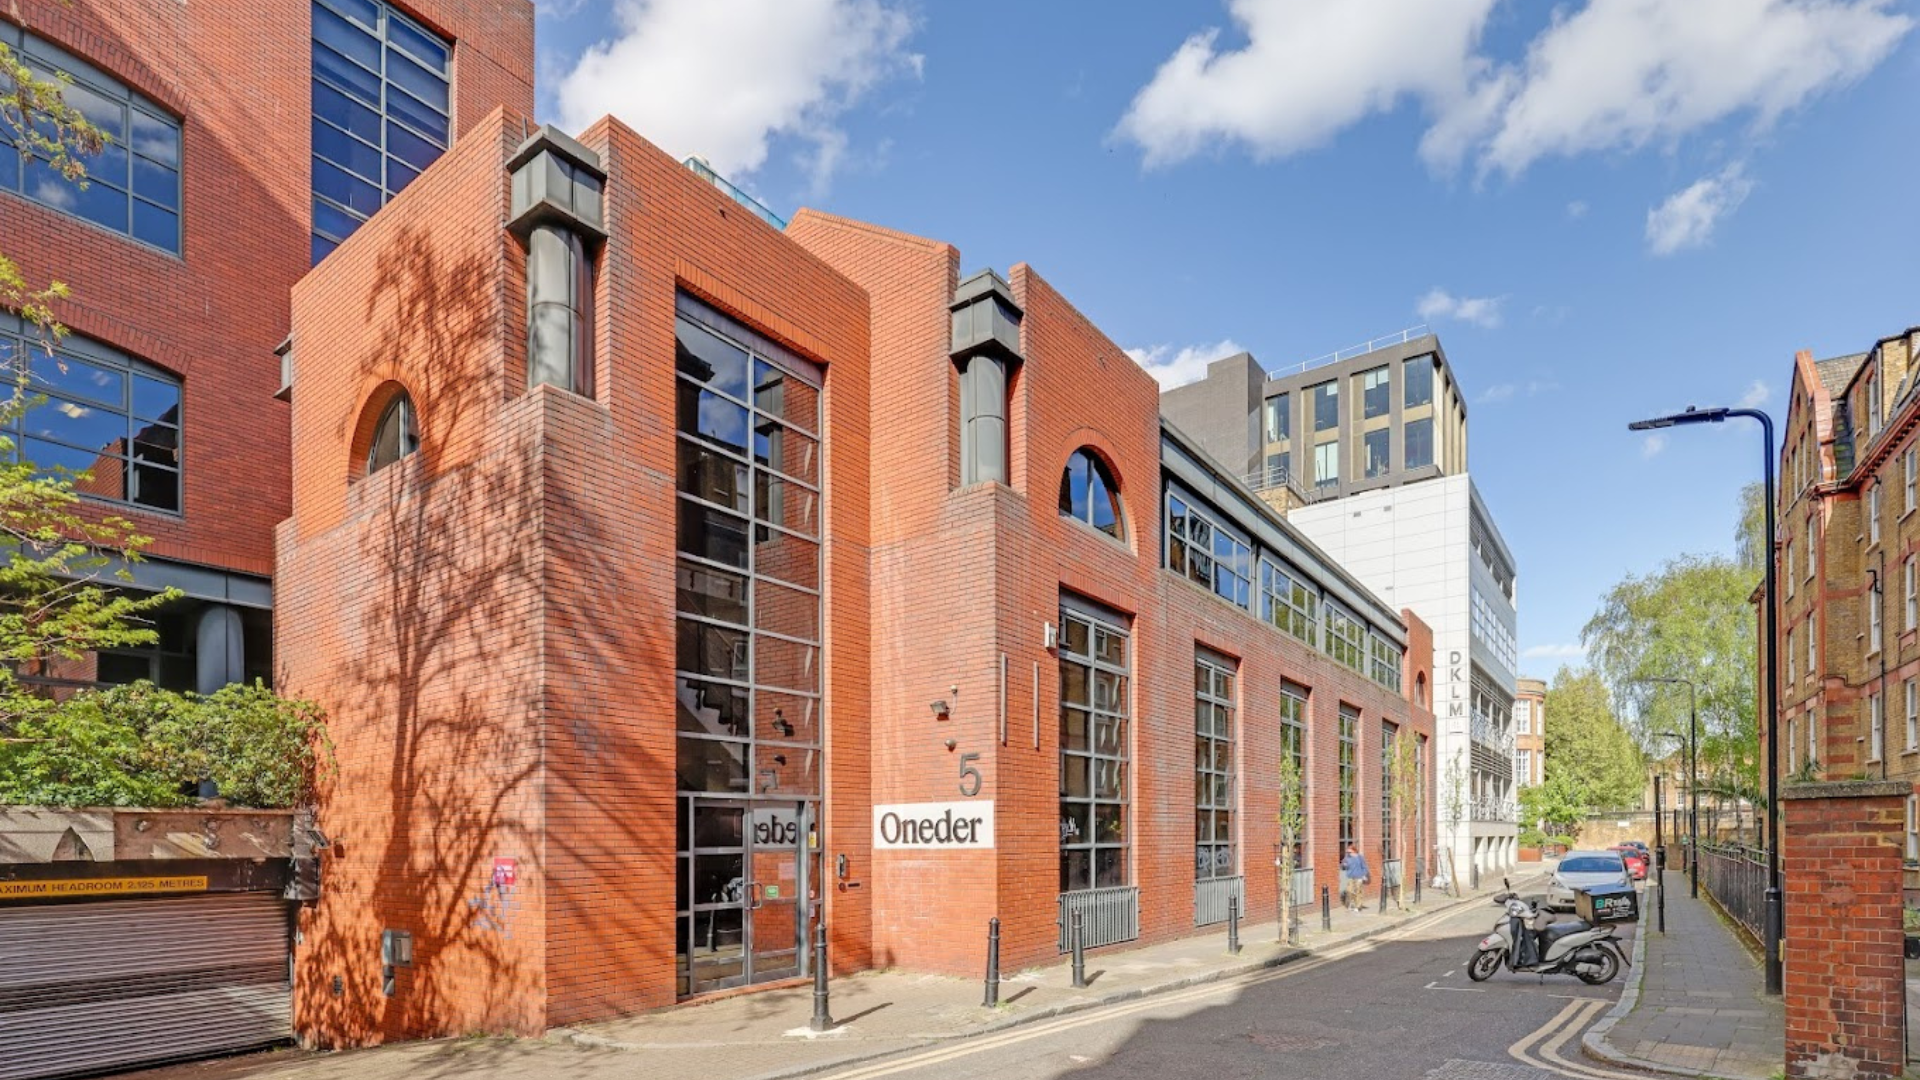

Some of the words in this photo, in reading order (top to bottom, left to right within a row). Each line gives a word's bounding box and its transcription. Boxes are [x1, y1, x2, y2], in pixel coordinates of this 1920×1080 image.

[1449, 650, 1463, 717] DKLM
[959, 752, 982, 797] 5
[880, 808, 983, 844] Oneder
[51, 880, 122, 892] HEADROOM
[127, 880, 154, 890] 2.125
[159, 878, 204, 889] METRES
